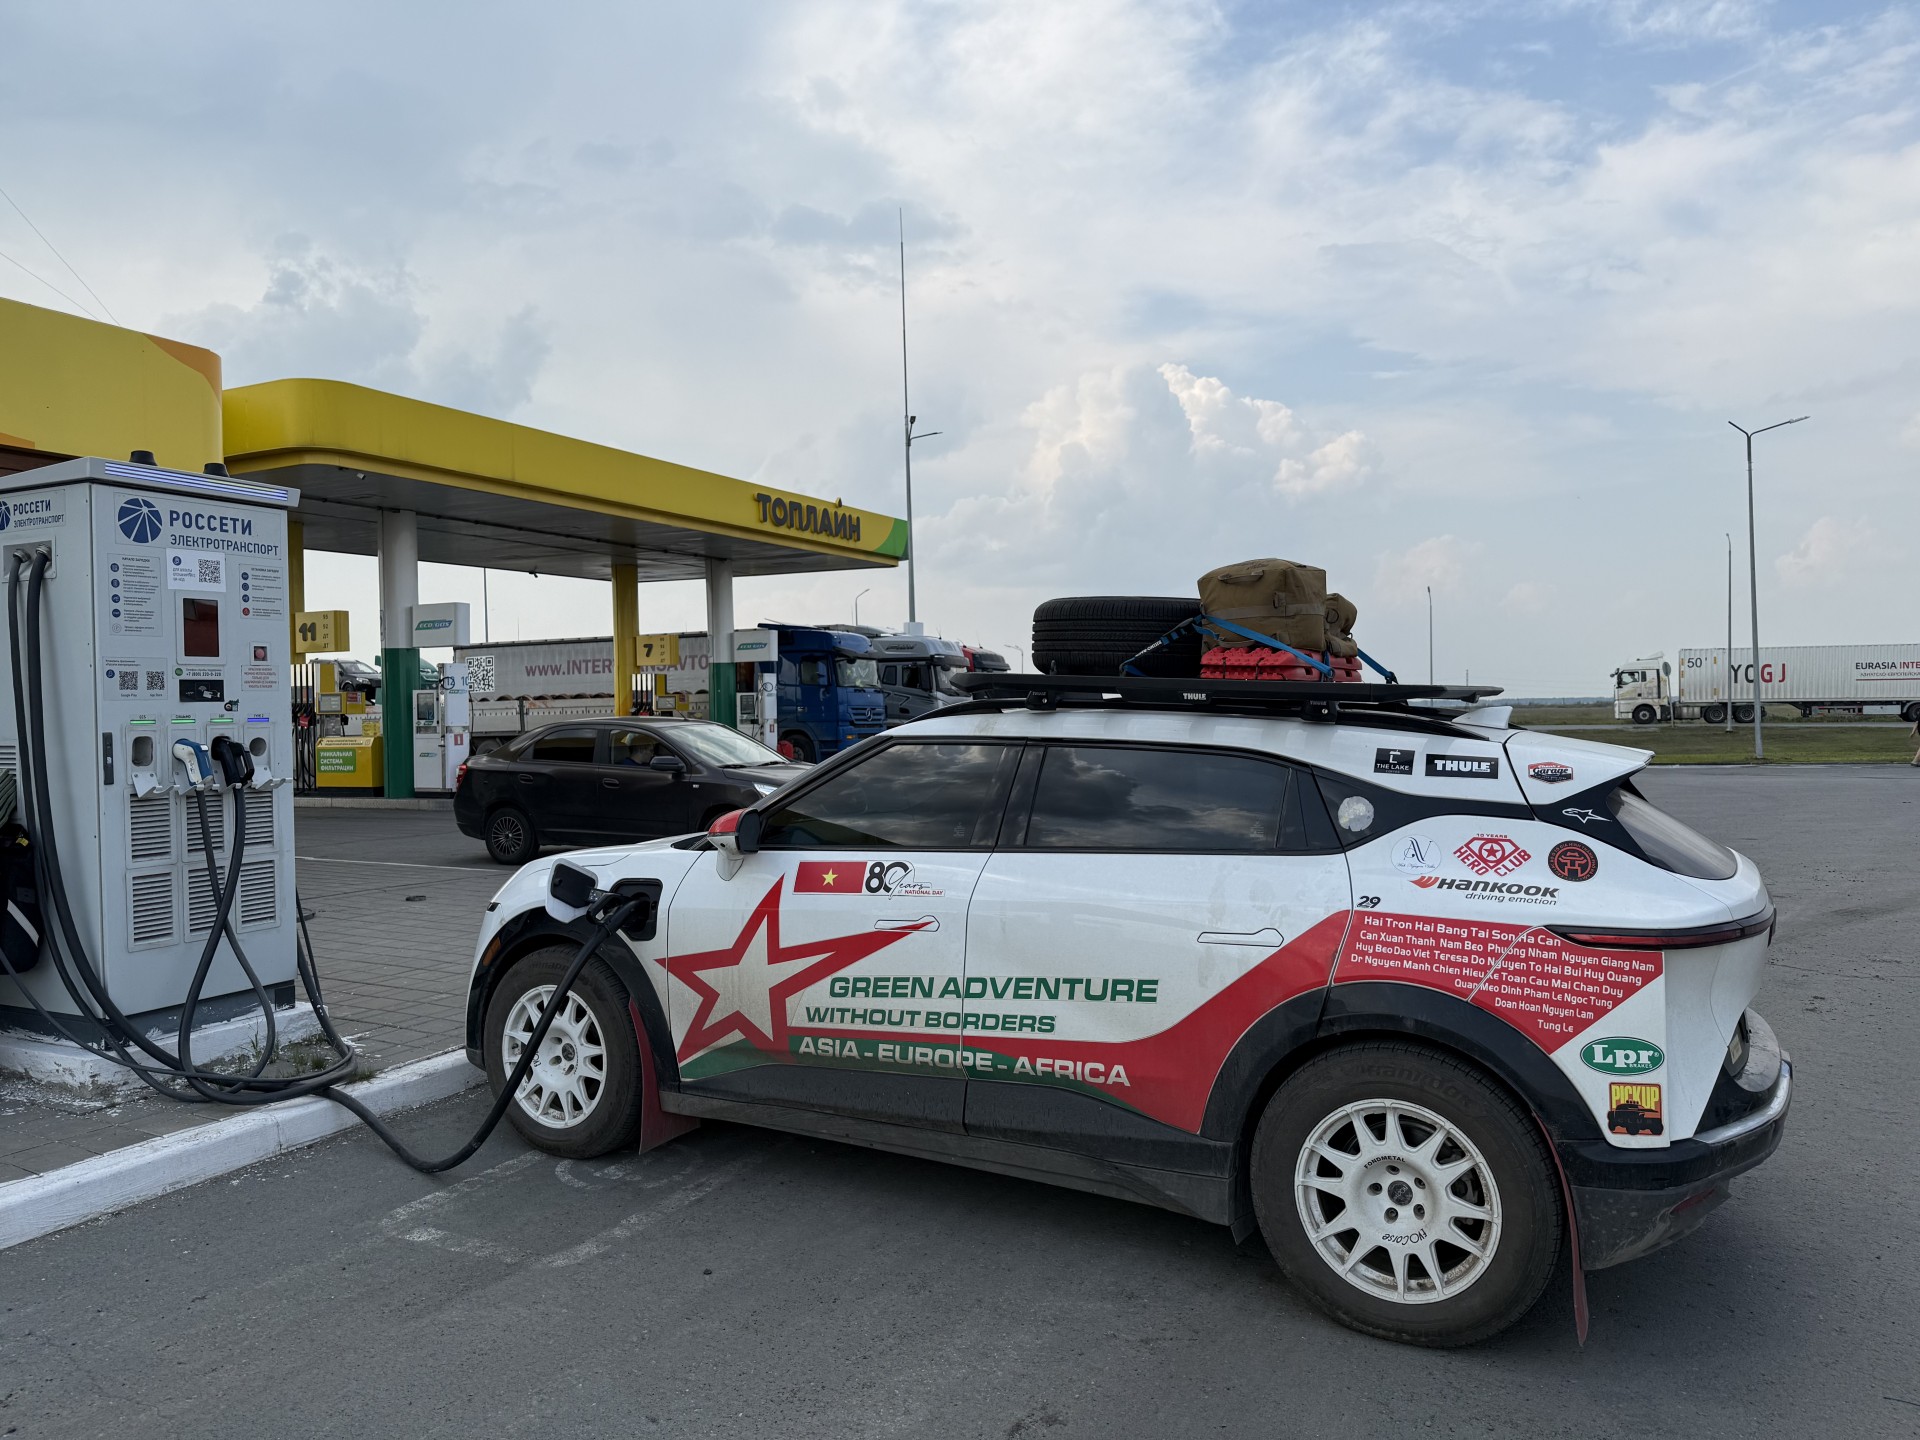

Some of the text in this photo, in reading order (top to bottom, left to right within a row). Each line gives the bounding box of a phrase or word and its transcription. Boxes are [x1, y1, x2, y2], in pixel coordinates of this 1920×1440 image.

[13, 499, 51, 516] РОССЕТИ
[14, 514, 65, 528] ЭЛЕКТРОТРАНСПОРТ
[169, 510, 252, 536] РОССЕТИ
[170, 534, 279, 556] ЭЛЕКТРОТРАНСПОРТ
[299, 622, 317, 642] 11
[643, 644, 653, 658] 7
[1855, 662, 1897, 670] EURASIA
[1434, 760, 1491, 773] THULE
[1453, 845, 1490, 876] HERO
[1494, 849, 1532, 877] CLUB
[1357, 895, 1381, 909] 29
[1465, 892, 1557, 906] driving emotion
[1364, 916, 1383, 927] Hai
[1385, 918, 1412, 930] Tron
[1415, 922, 1434, 932] Hai
[1437, 924, 1468, 938] Bang
[1470, 927, 1489, 938] Tai
[1492, 930, 1515, 941] Son
[1538, 935, 1561, 947] Can
[1360, 930, 1655, 972] Can Xuan Thanh Nam Beo Phuong Nham Nguyen Giang Nam
[1351, 953, 1363, 963] Dr
[1365, 956, 1401, 968] Nguyen
[1403, 960, 1431, 971] Manh
[1433, 963, 1460, 975] Chien
[1462, 967, 1485, 978] Hieu
[1501, 972, 1527, 984] Toan
[1529, 976, 1549, 987] Cau
[1551, 978, 1571, 990] Mai
[1573, 981, 1600, 993] Chan
[1602, 985, 1624, 998] Duy
[1356, 942, 1373, 954] Huy
[1375, 944, 1393, 954] Beo
[1394, 946, 1411, 957] Dao
[1413, 948, 1430, 959] Viet
[1433, 950, 1469, 963] Teresa
[1471, 955, 1486, 966] Do
[1529, 961, 1542, 972] To
[1544, 963, 1562, 975] Hai
[1564, 966, 1582, 977] Bui
[1584, 968, 1605, 982] Huy
[1606, 971, 1642, 986] Quang
[829, 976, 1160, 1003] GREEN ADVENTURE
[1480, 982, 1499, 993] Meo
[1501, 984, 1522, 996] Dinh
[1524, 987, 1550, 999] Pham
[1552, 991, 1562, 1001] Le
[1564, 993, 1588, 1005] Ngoc
[1590, 996, 1613, 1010] Tung
[805, 1006, 1056, 1033] WITHOUT BORDERS
[1495, 997, 1594, 1020] Doan Hoan Nguyen Lam
[1537, 1019, 1574, 1033] Tung Le
[798, 1036, 861, 1060] ASIA
[877, 1043, 994, 1073] EUROPE
[1012, 1056, 1131, 1087] AFRICA
[1592, 1044, 1653, 1068] Lpr
[1611, 1084, 1660, 1110] PICKUP
[1364, 1155, 1406, 1170] FONDMETAL
